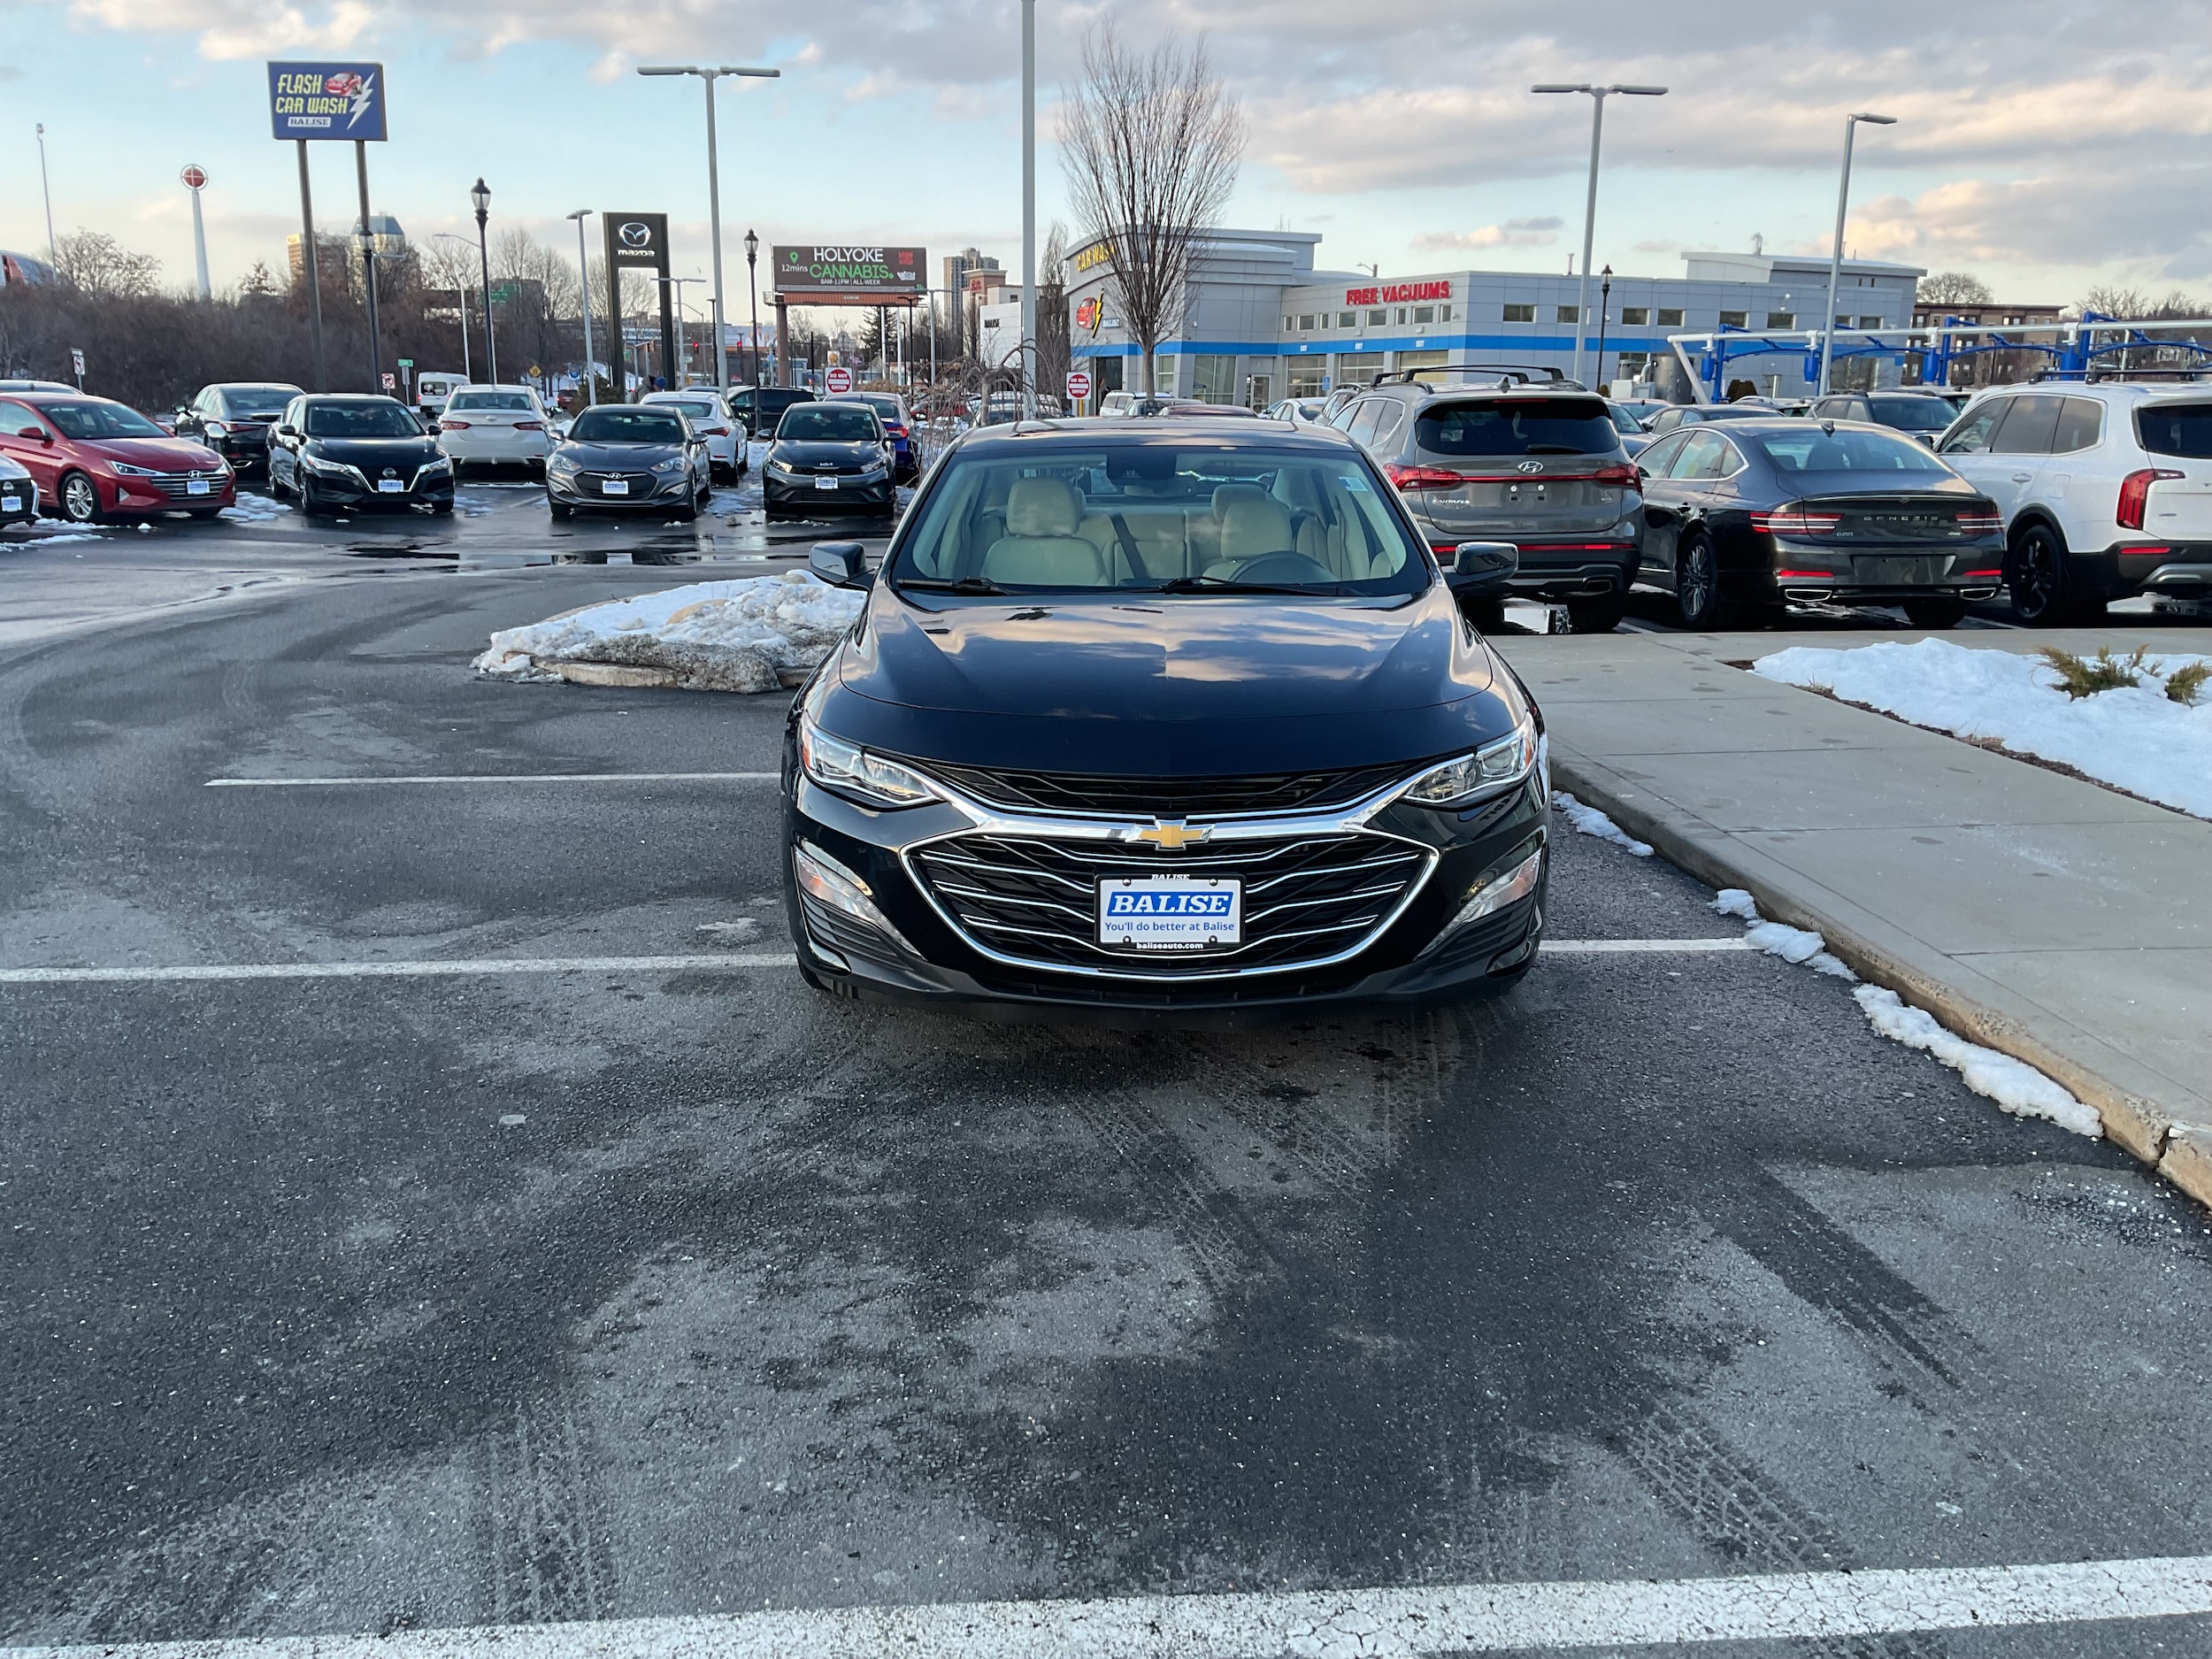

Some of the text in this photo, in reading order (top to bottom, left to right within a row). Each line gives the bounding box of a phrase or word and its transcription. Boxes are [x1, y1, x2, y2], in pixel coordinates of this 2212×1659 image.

[277, 73, 323, 94] FLASH
[275, 96, 349, 113] CAR WASH
[813, 247, 884, 263] HOLYOKE
[1076, 250, 1092, 273] CAR
[781, 264, 809, 273] 12mins
[1346, 280, 1452, 306] FREE VACUUMS
[1110, 895, 1229, 913] BALISE
[1105, 922, 1133, 931] You'll
[1136, 922, 1149, 931] do
[1153, 922, 1187, 931] better
[1203, 922, 1235, 931] Balise
